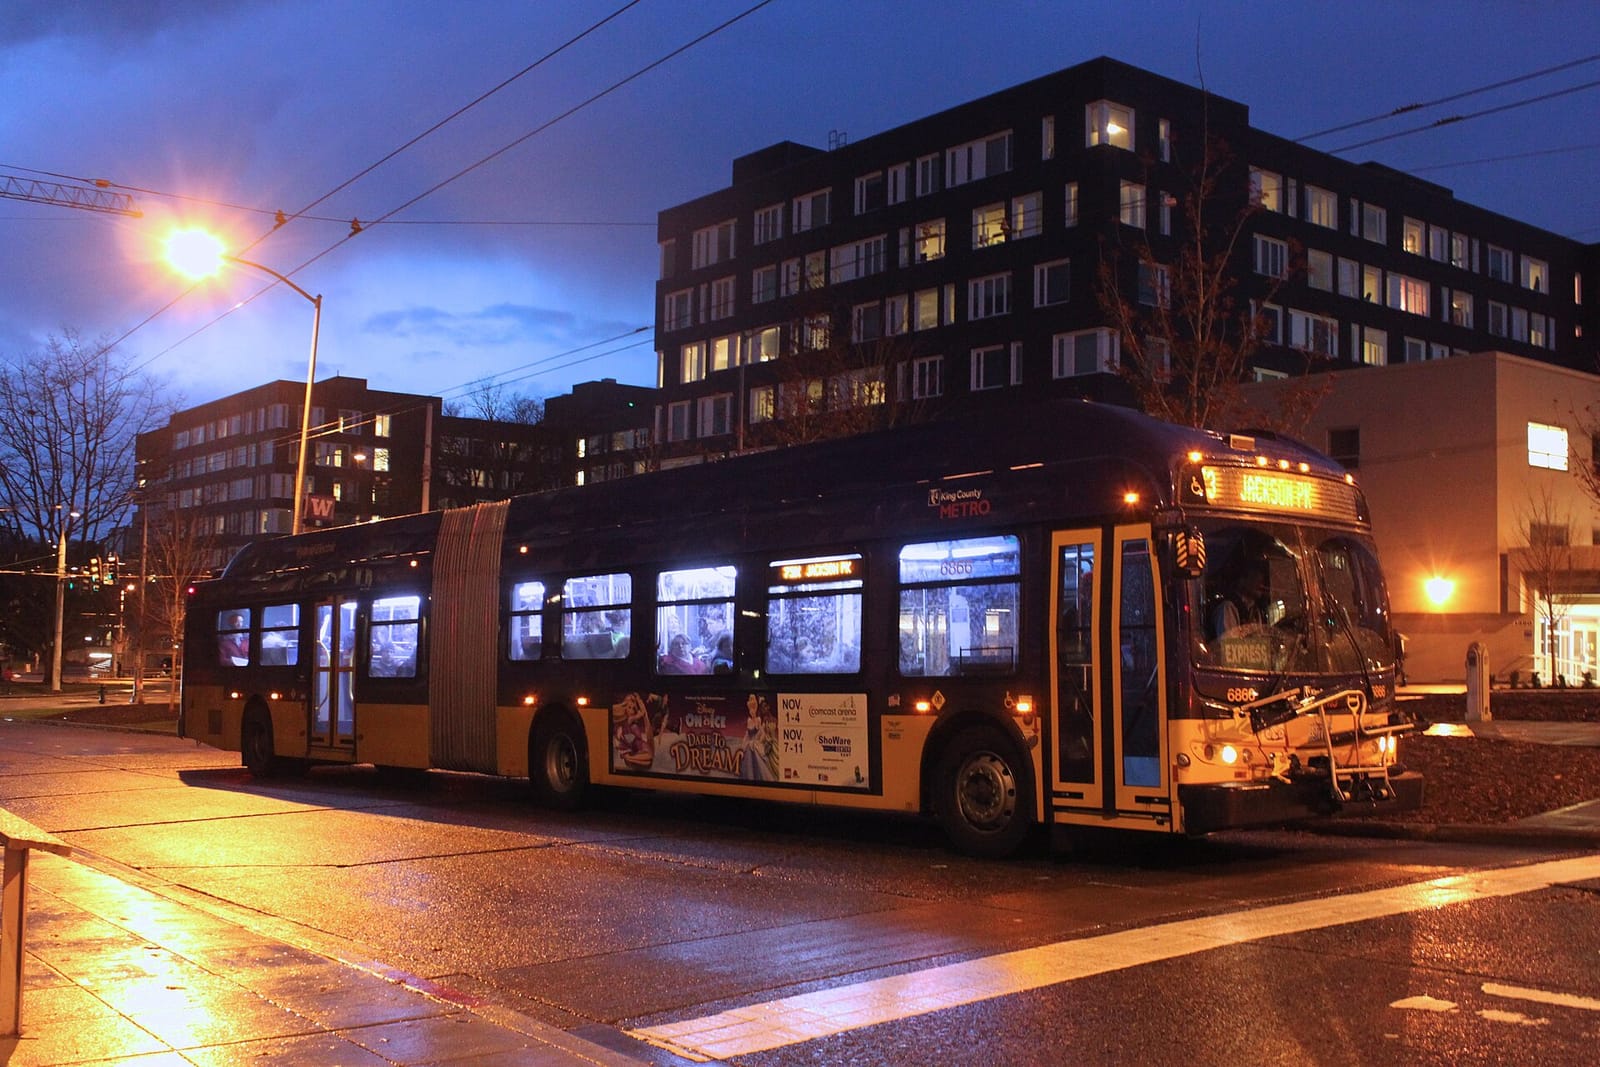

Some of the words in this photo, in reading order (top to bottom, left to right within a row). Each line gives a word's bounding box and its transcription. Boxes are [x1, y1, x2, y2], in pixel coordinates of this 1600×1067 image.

[940, 492, 957, 502] King
[957, 489, 982, 499] County
[1240, 474, 1293, 507] JACKSON
[311, 498, 333, 517] W
[939, 499, 991, 519] METRO
[940, 560, 973, 576] 6866
[1225, 644, 1268, 666] EXPRESS
[685, 712, 702, 728] ON
[687, 733, 712, 746] DARE
[818, 735, 851, 746] ShoWare
[784, 742, 803, 754] 7-11
[671, 743, 745, 776] DREAM
